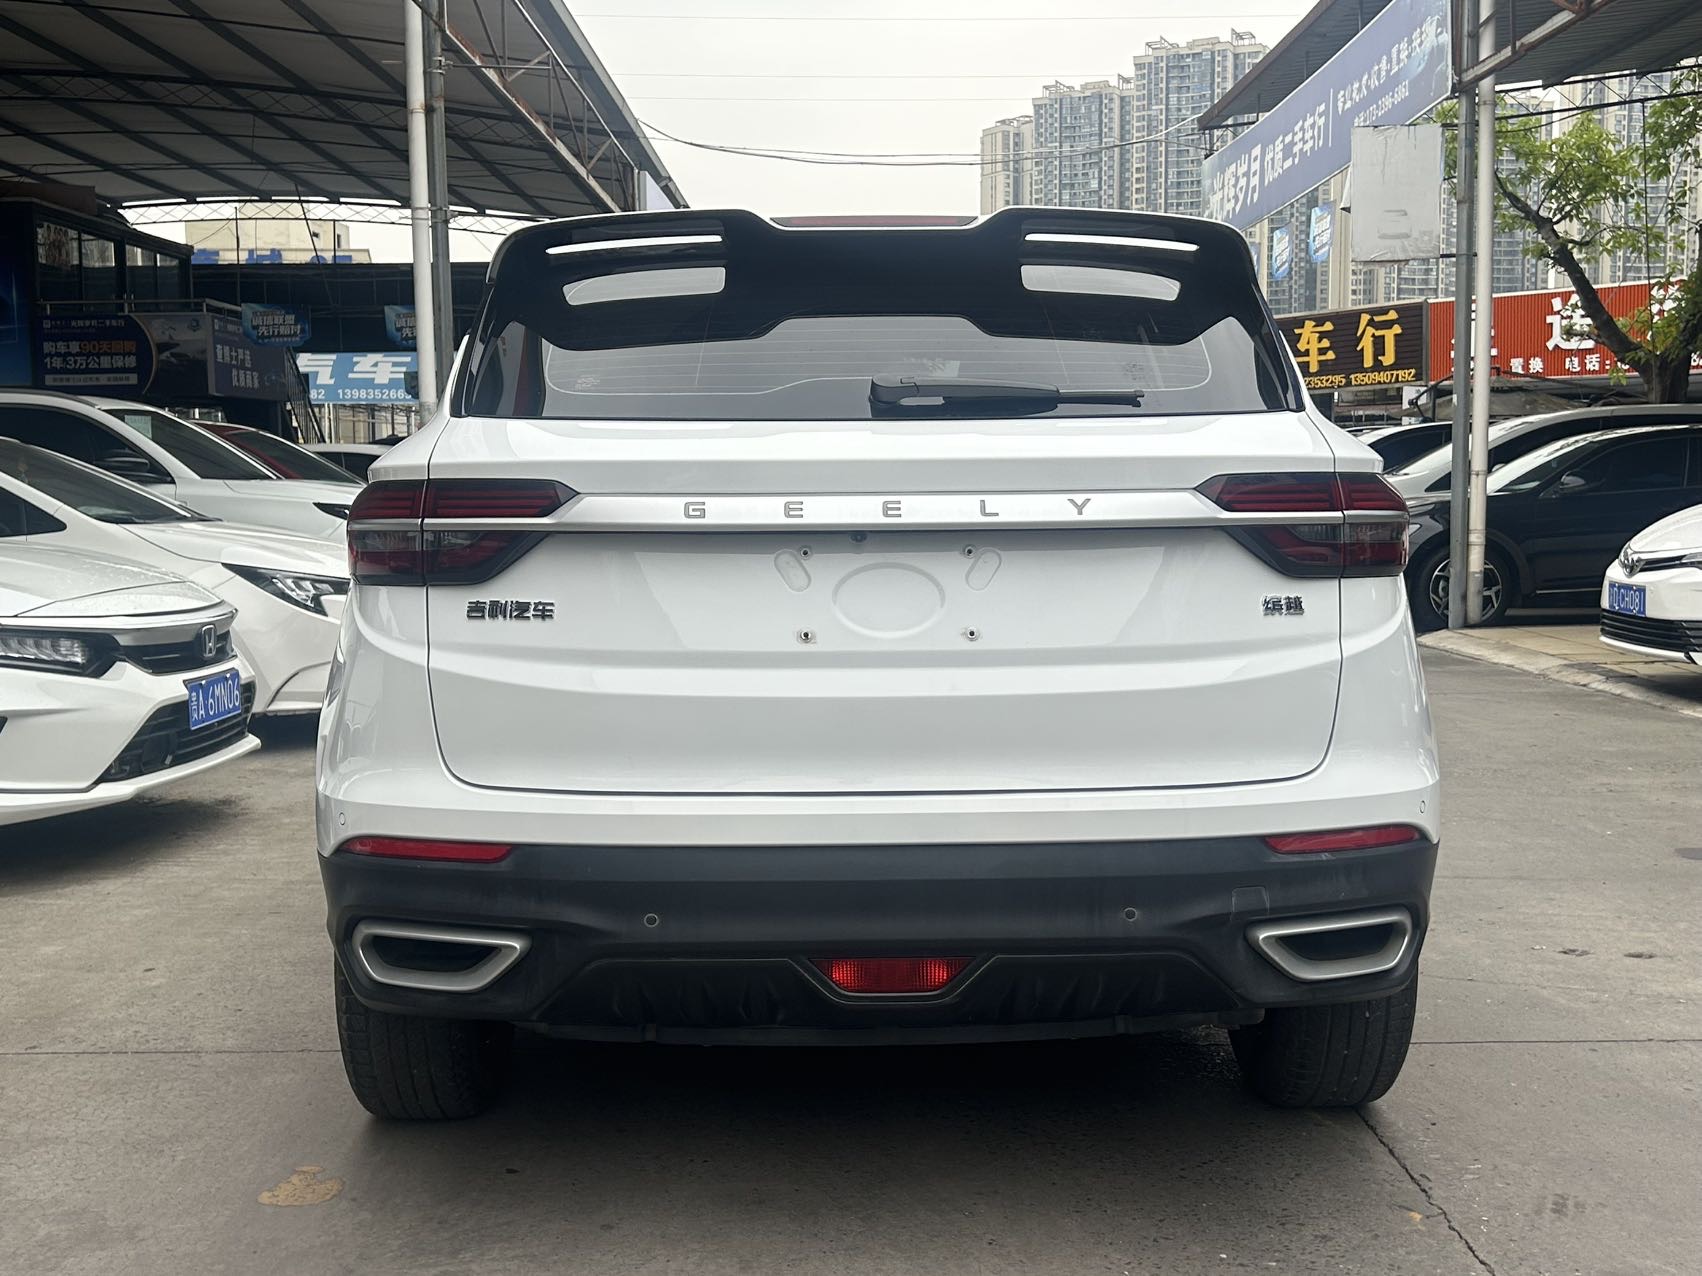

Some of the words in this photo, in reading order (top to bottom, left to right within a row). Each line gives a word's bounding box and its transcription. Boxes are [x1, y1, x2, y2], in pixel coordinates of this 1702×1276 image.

[1204, 143, 1261, 221] 光辉岁月
[1264, 102, 1326, 187] 优质二手车行
[1294, 309, 1402, 373] 车行
[1349, 367, 1416, 386] 13509407192
[684, 498, 1092, 520] GEELY
[466, 600, 555, 621] 吉利汽车
[1262, 595, 1305, 616] 缤越
